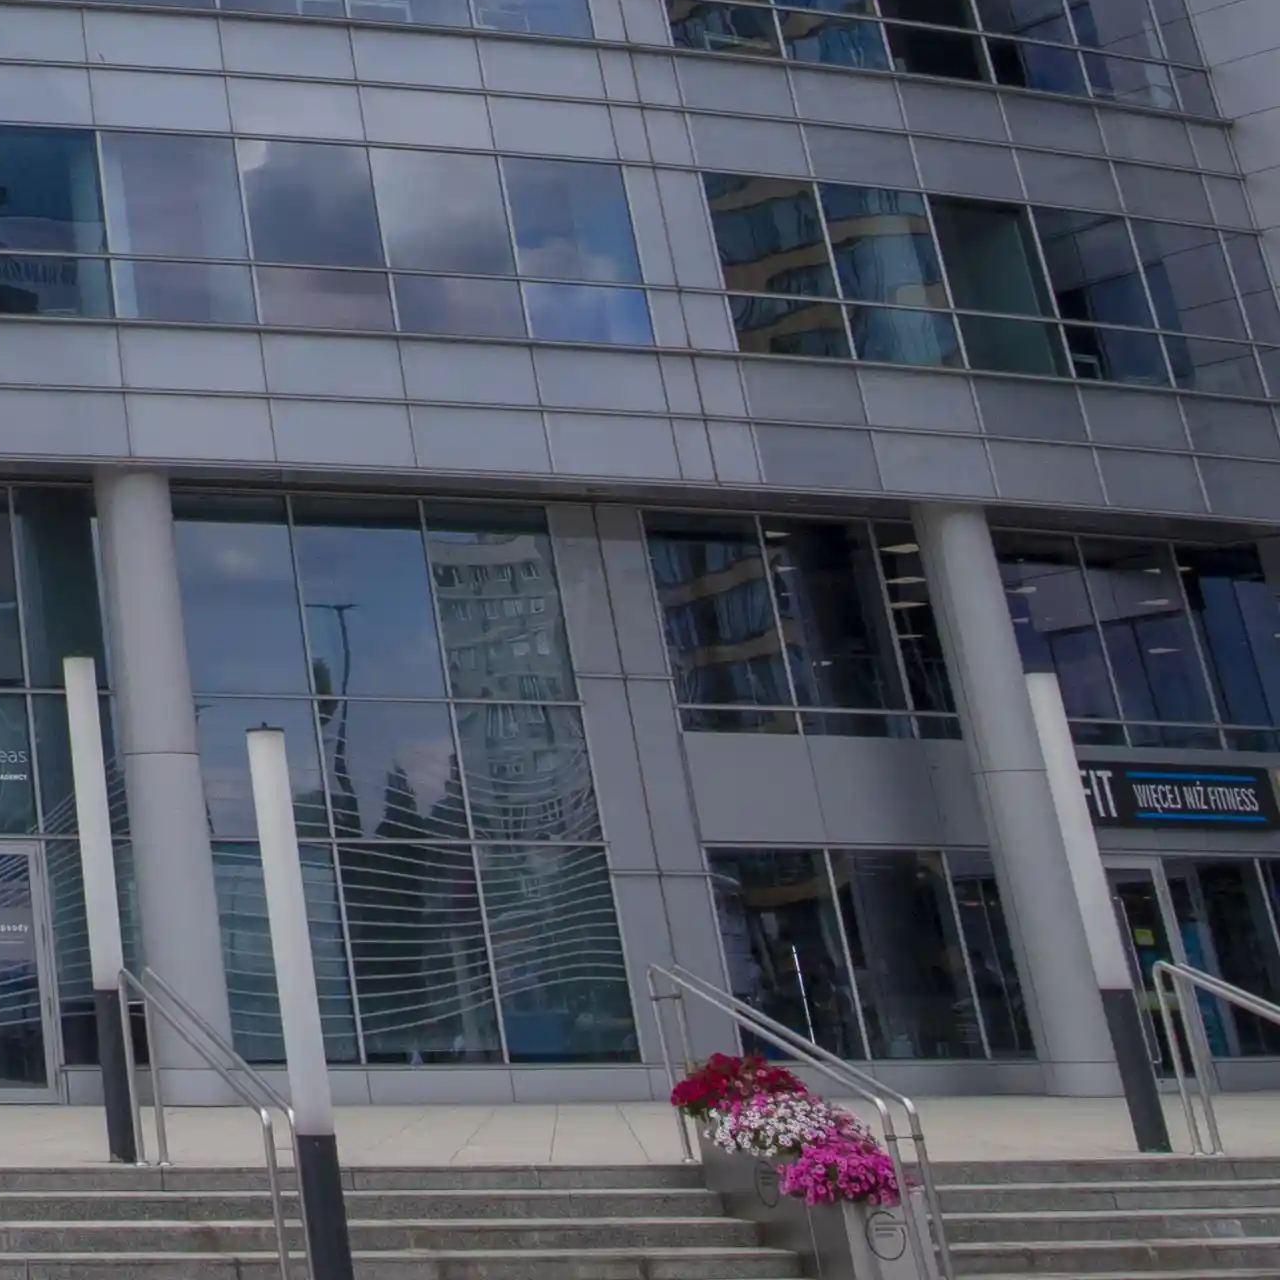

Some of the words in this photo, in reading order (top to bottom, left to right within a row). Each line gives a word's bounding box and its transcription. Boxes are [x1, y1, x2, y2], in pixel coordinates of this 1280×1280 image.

[1132, 783, 1182, 813] WIĘCEJ
[1182, 780, 1209, 810] NIŻ
[1207, 786, 1259, 812] FITNESS
